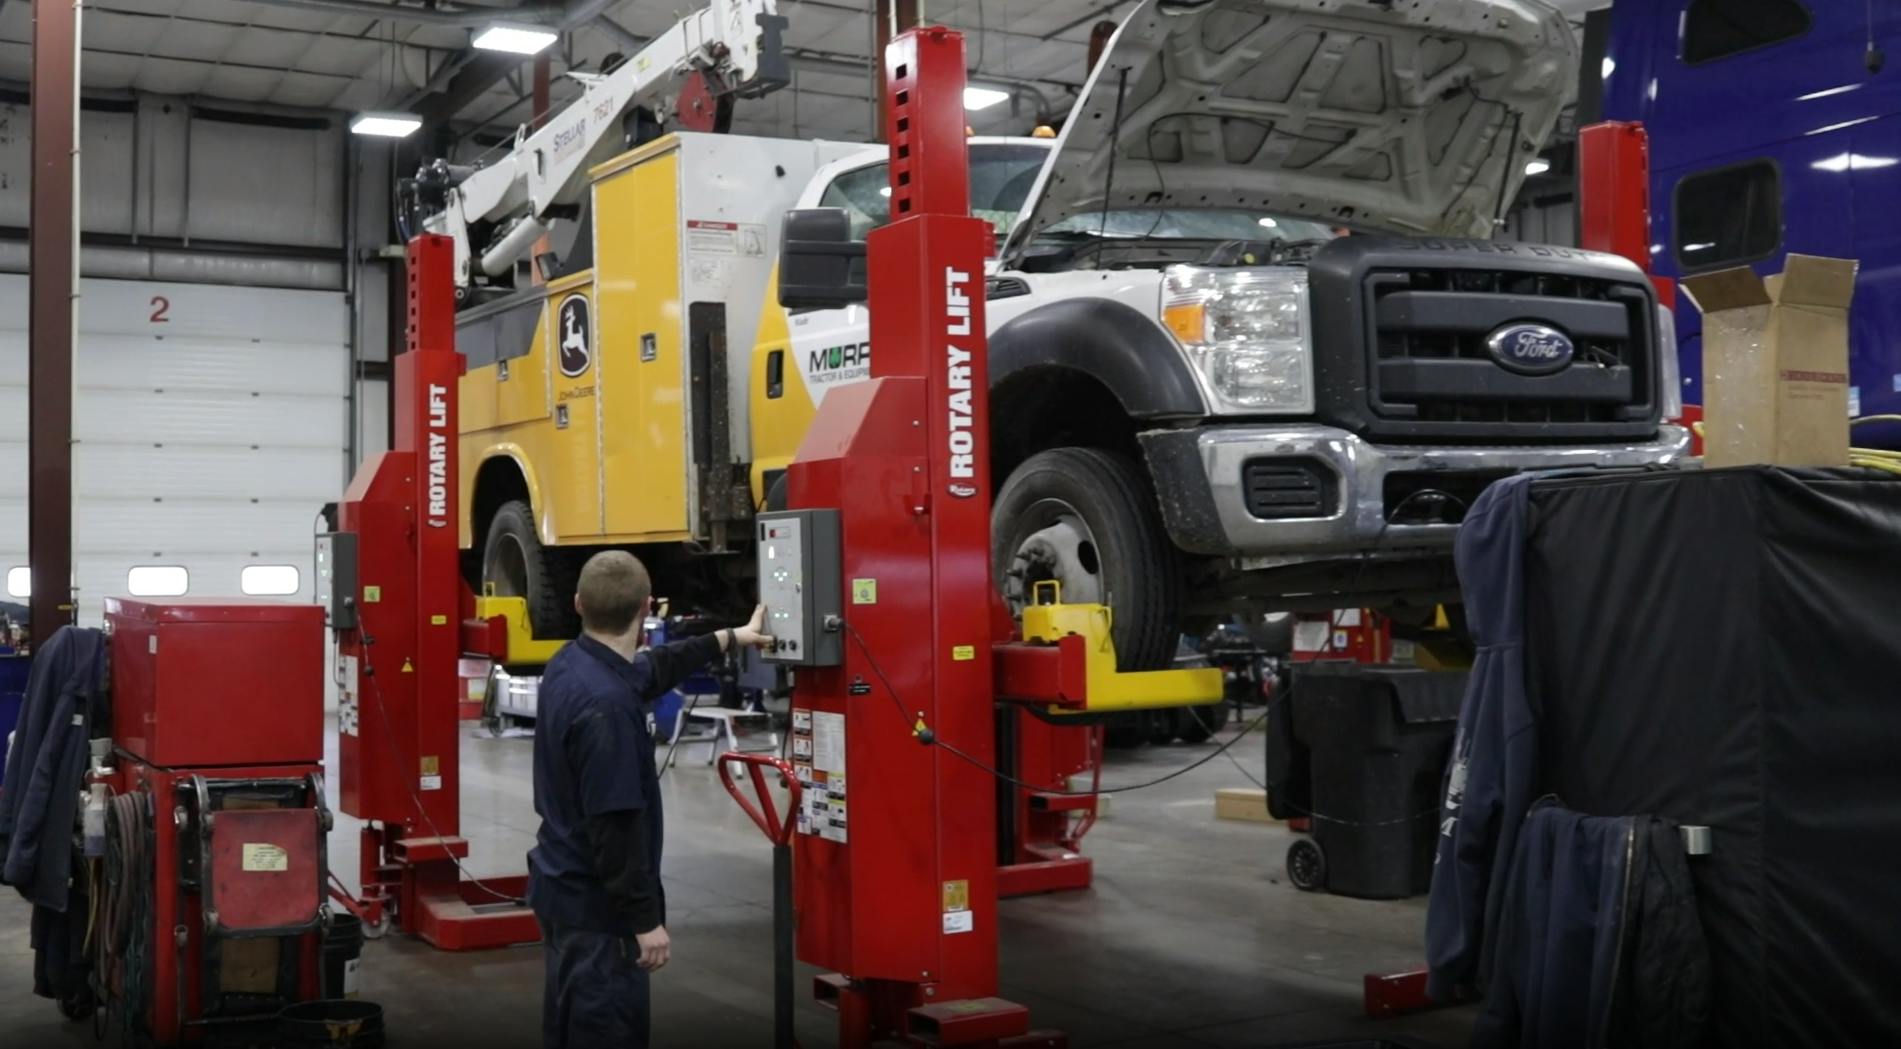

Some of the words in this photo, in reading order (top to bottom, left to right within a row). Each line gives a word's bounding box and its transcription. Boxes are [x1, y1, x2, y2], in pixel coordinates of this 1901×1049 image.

[150, 296, 170, 322] 2
[946, 266, 971, 336] LIFT
[1514, 331, 1564, 358] Ford
[429, 383, 447, 427] LIFT
[947, 344, 974, 478] ROTARY
[428, 431, 447, 516] ROTARY
